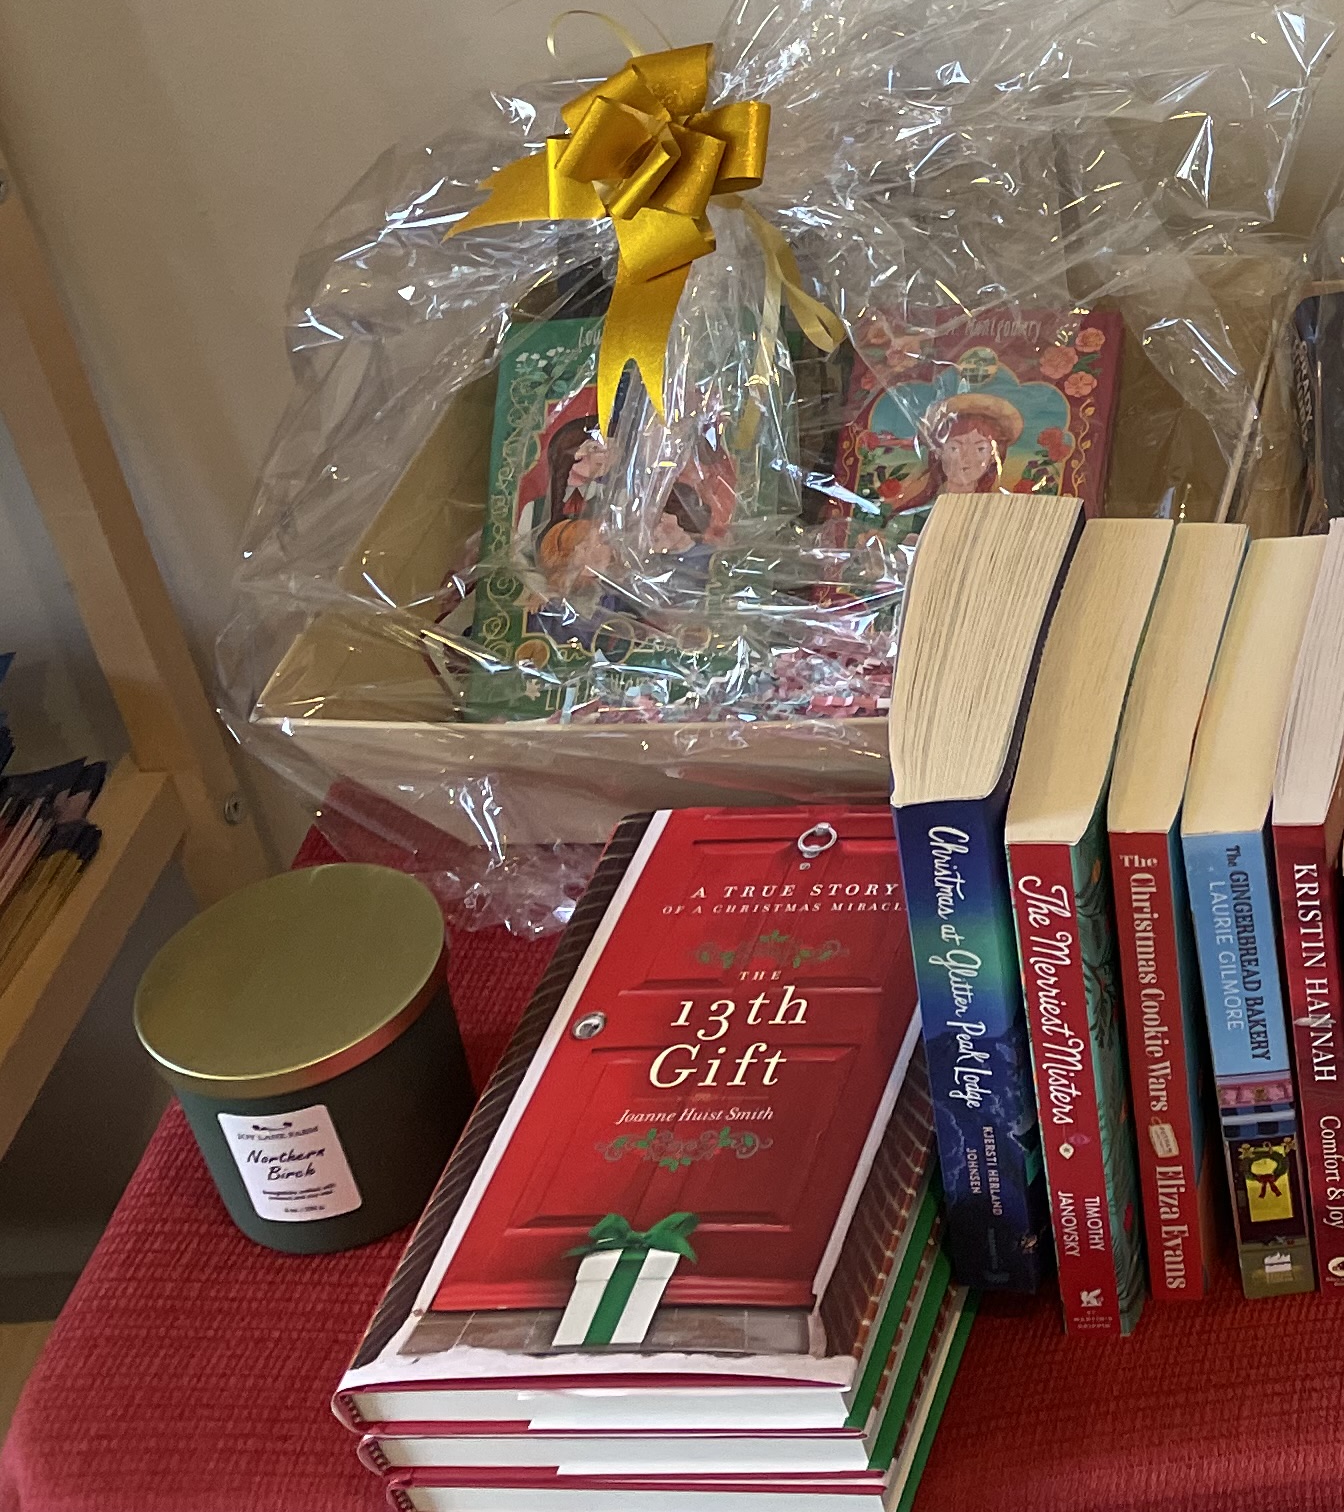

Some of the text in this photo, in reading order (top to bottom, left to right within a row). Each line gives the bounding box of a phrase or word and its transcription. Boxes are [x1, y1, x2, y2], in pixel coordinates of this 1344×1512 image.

[662, 901, 909, 915] OF A CHRISTMAS MIRACL
[690, 883, 899, 898] A TRUE STORY
[738, 970, 783, 981] THE
[928, 826, 992, 1109] Christmas at Glitter Peak Lodge
[1208, 880, 1245, 1031] LAURIE GILMORE
[1226, 845, 1271, 1061] The GINGERBREAD BAKERY
[1293, 863, 1337, 1082] KRISTIN HANNAH
[1018, 875, 1085, 1125] The Merriest Misters
[1119, 854, 1173, 1112] The Christmas Cookie Wars
[670, 986, 809, 1041] 13th
[649, 1042, 788, 1089] Gift
[615, 1106, 774, 1125] Joanne Huist Smith
[247, 1148, 326, 1164] Northern
[267, 1163, 316, 1181] Birch
[966, 1147, 983, 1195] JOHNSEN
[1319, 1115, 1344, 1182] Comfort
[988, 1168, 1003, 1217] HERLAND
[1057, 1190, 1080, 1257] JANOVSKY
[1084, 1195, 1106, 1251] TIMOTHY
[1155, 1165, 1190, 1289] Eliza Evans
